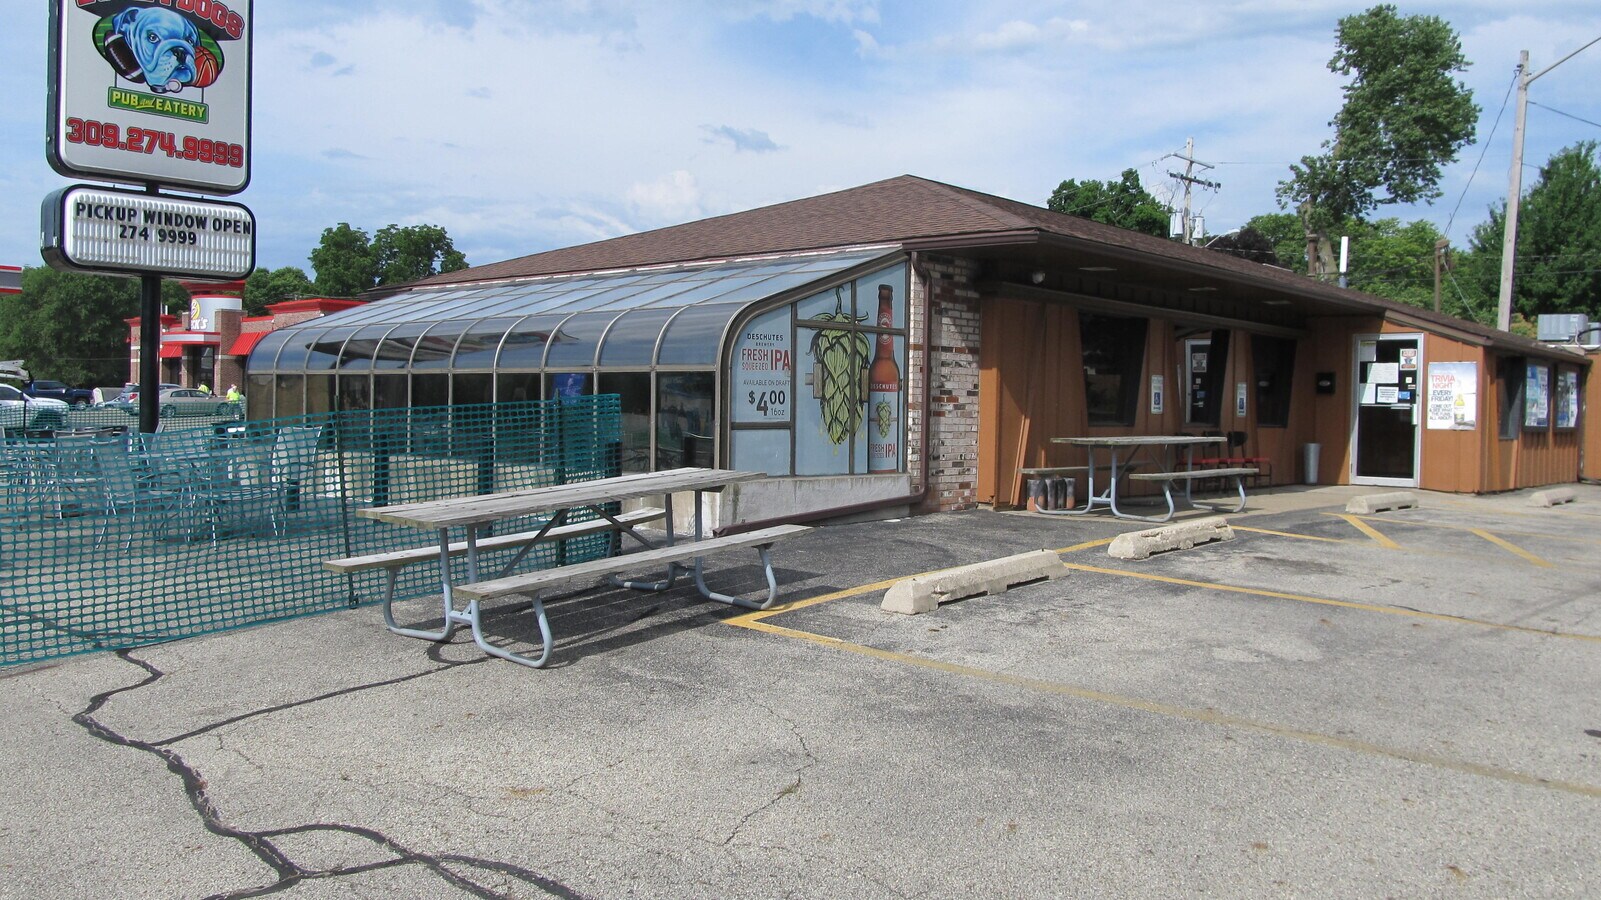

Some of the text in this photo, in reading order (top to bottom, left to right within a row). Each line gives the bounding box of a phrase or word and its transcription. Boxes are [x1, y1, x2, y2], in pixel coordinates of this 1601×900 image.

[112, 91, 139, 106] PUB
[156, 98, 205, 118] EATERY
[66, 117, 243, 167] 309.274.9999
[76, 202, 250, 234] PICKUP WINDOW OPEN
[119, 225, 197, 246] 274 9999
[747, 333, 784, 341] DESCHUTES
[742, 348, 791, 371] FRESH IPA
[742, 361, 768, 370] SQUEEZED
[775, 379, 791, 387] DRAFT
[1431, 374, 1455, 382] TRIVIA
[770, 408, 785, 416] 16oz
[885, 443, 897, 458] IPA
